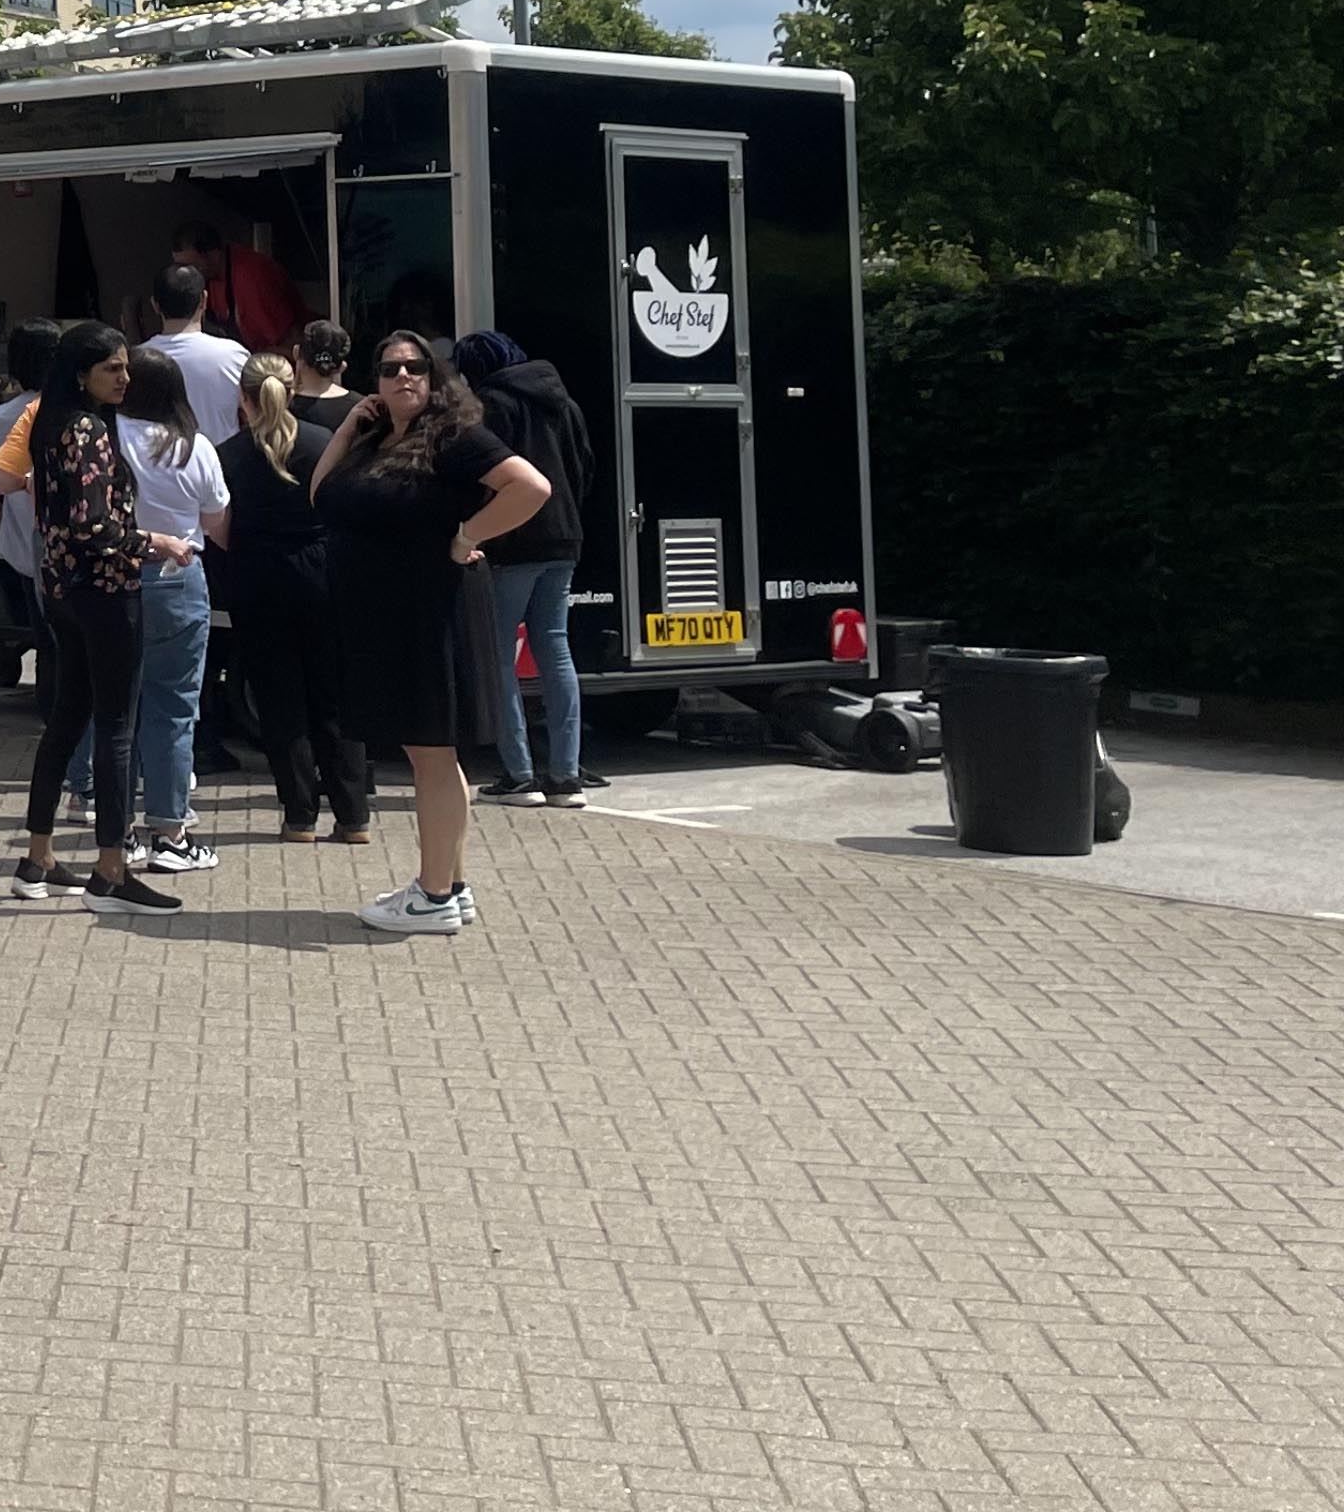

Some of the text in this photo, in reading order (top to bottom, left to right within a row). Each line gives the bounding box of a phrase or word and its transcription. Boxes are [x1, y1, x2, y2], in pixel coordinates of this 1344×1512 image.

[647, 299, 715, 334] Chef Stef
[654, 615, 734, 642] MF70 QTY
